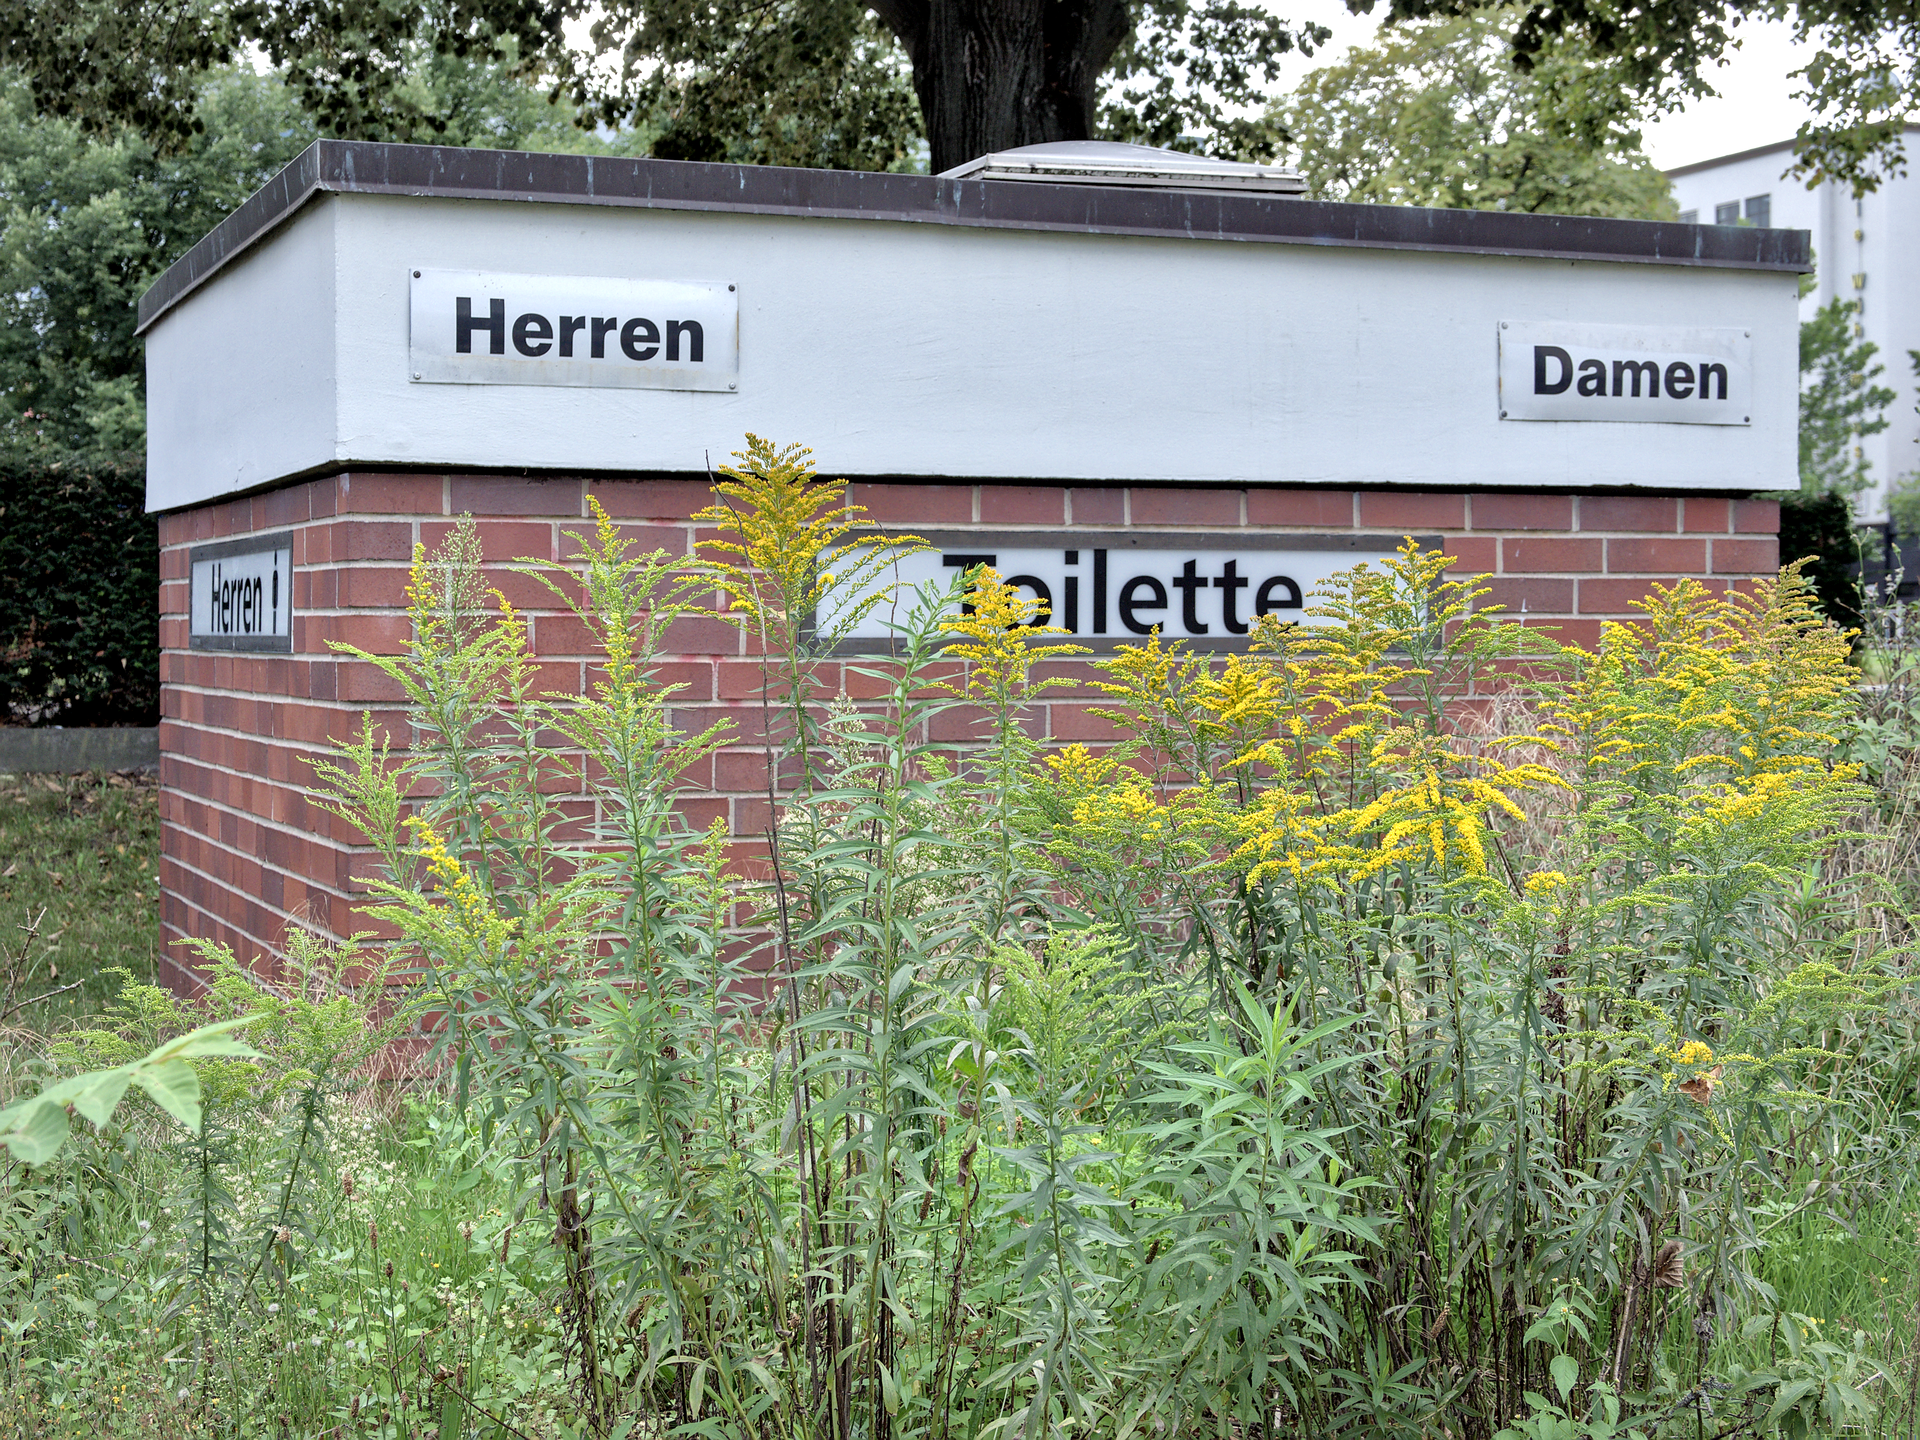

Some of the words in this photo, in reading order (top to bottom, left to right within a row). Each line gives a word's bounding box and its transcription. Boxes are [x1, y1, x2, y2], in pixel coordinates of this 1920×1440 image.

[456, 297, 704, 362] Herren
[1534, 345, 1728, 400] Damen
[211, 562, 262, 633] Herren
[943, 549, 1303, 635] Toilette
